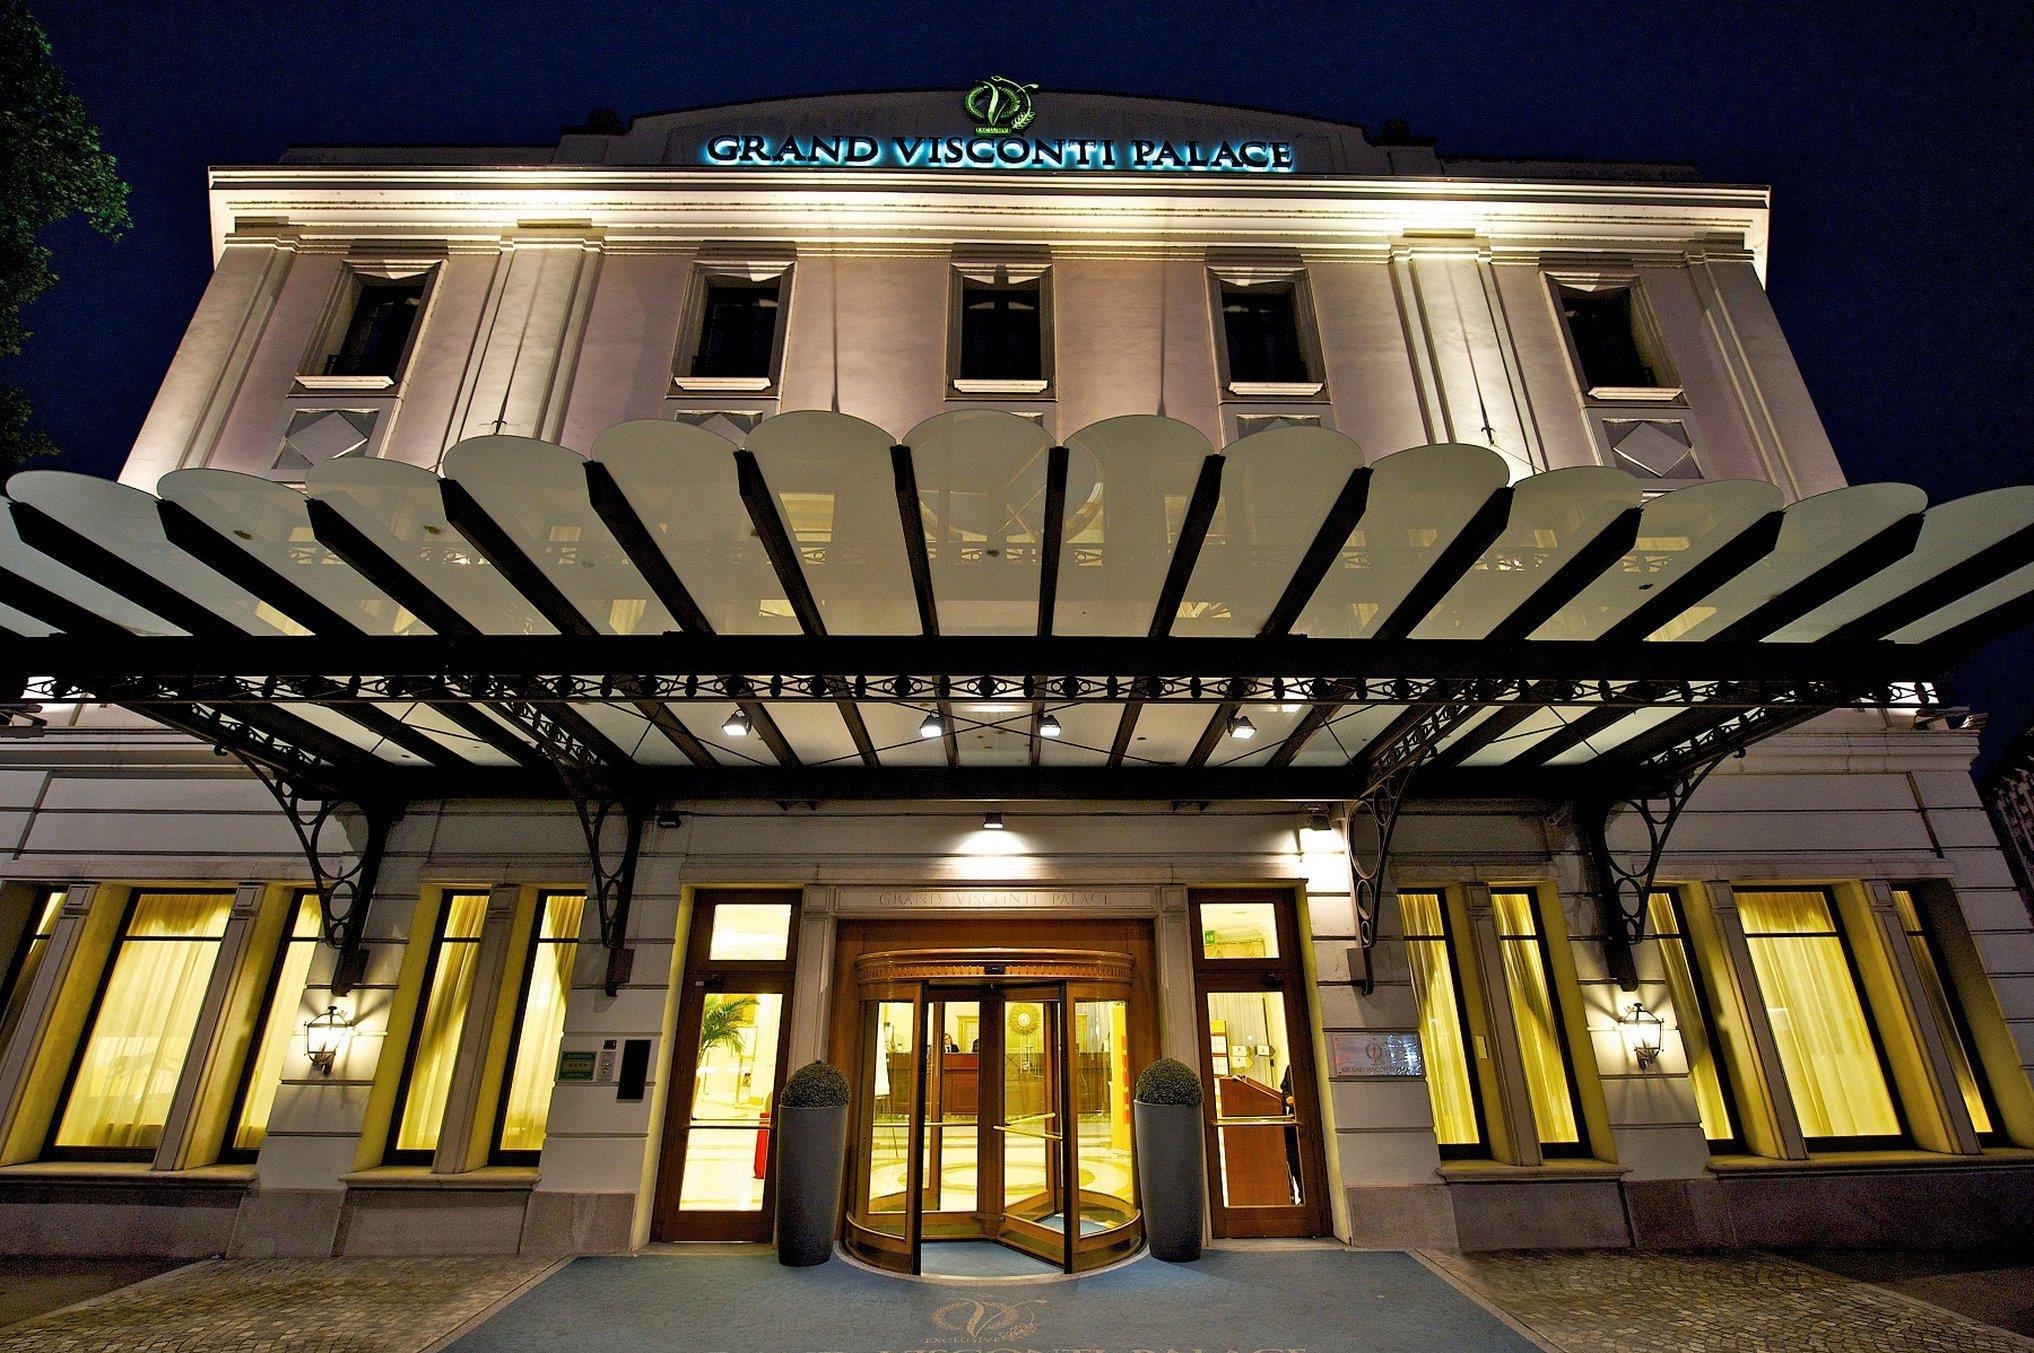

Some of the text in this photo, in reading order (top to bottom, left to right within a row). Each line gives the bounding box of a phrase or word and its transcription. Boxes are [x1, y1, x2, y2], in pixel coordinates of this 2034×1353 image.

[706, 134, 1294, 168] GRAND VISCONTI PALACE
[879, 893, 1110, 906] GRAND VISCONTI PALACE
